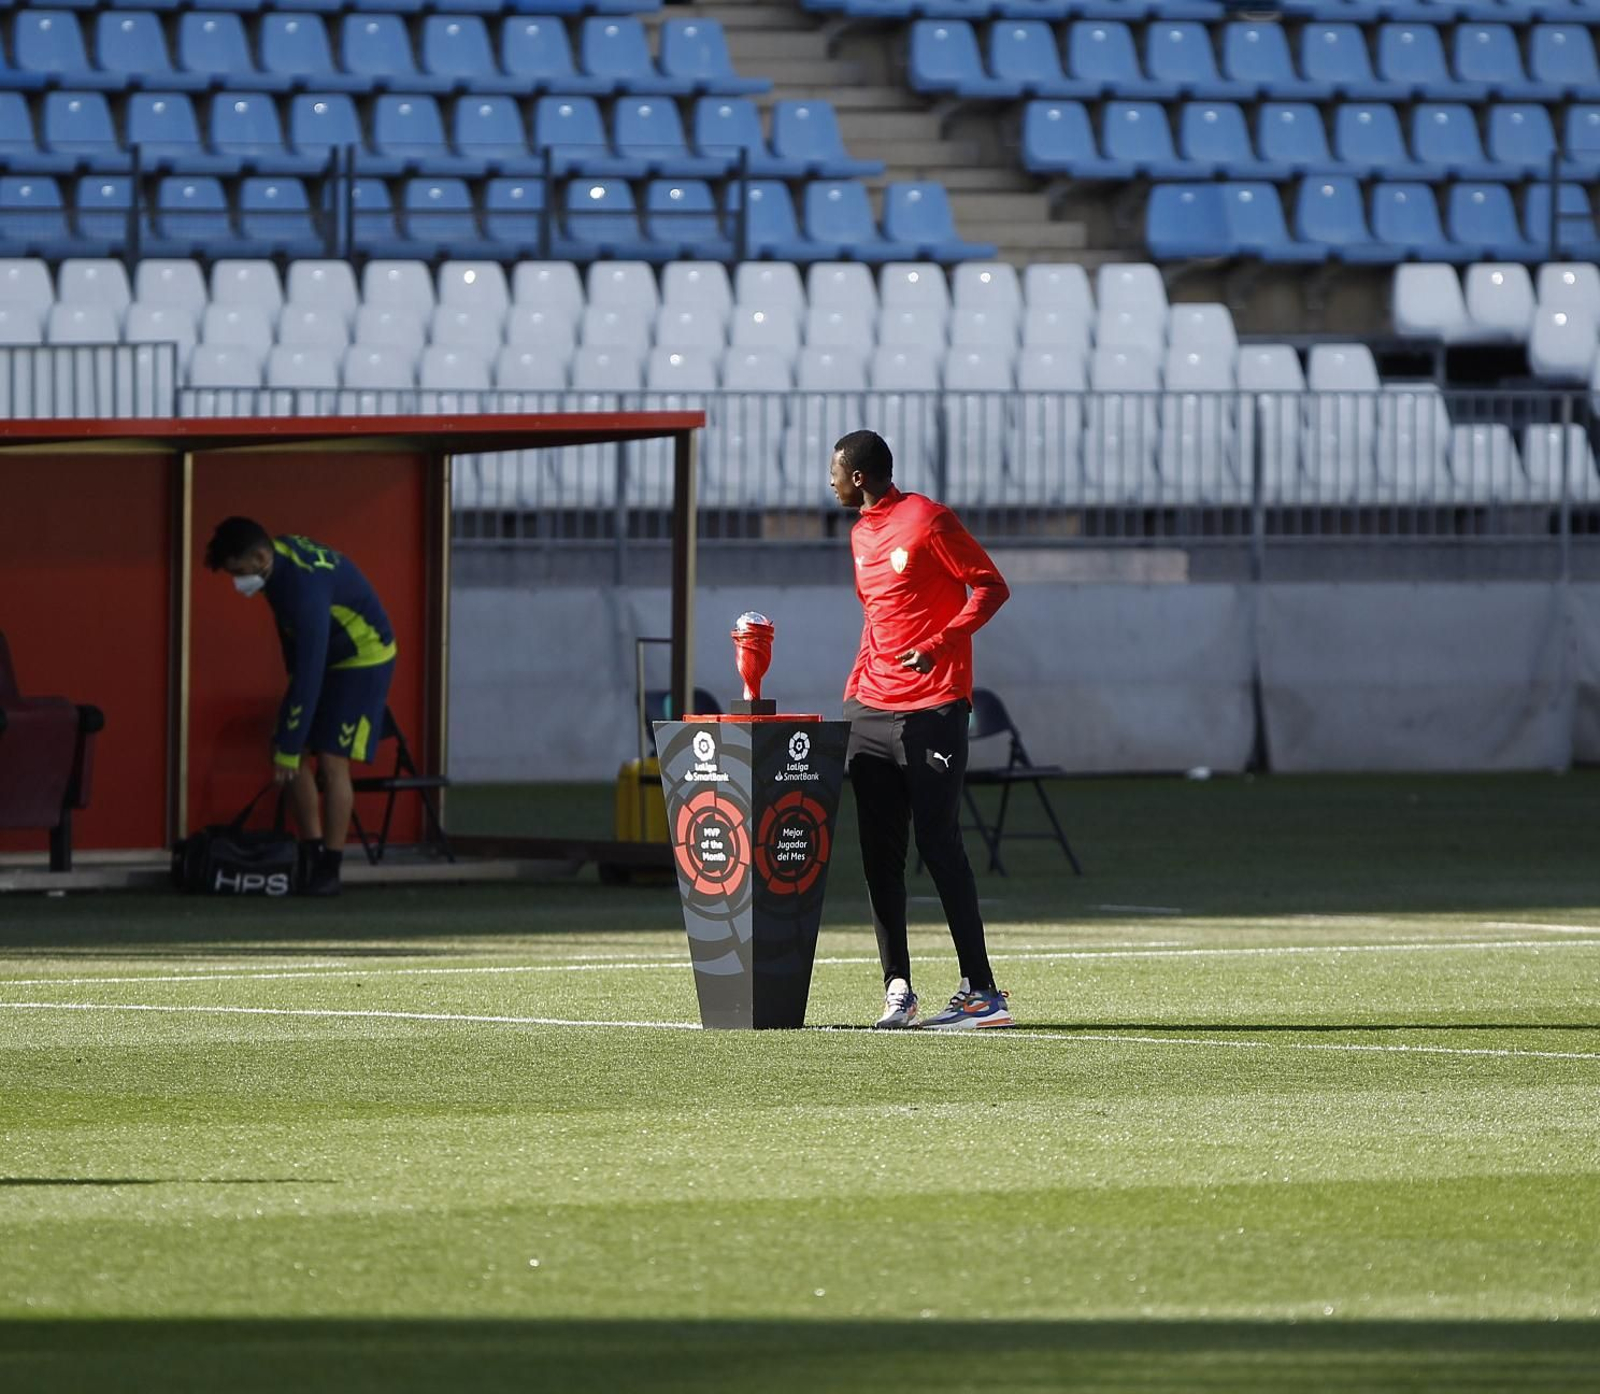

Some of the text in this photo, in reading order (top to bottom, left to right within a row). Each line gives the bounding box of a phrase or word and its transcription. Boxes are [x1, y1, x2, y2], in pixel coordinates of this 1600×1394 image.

[787, 762, 809, 772] LaLiga
[783, 772, 819, 782] SmartBank
[703, 828, 721, 838] MVP
[782, 828, 804, 839] Mejor
[710, 840, 724, 850] the
[777, 840, 808, 851] Jugador
[702, 851, 726, 861] Month
[777, 852, 806, 861] del Mes
[214, 868, 289, 896] HPS
